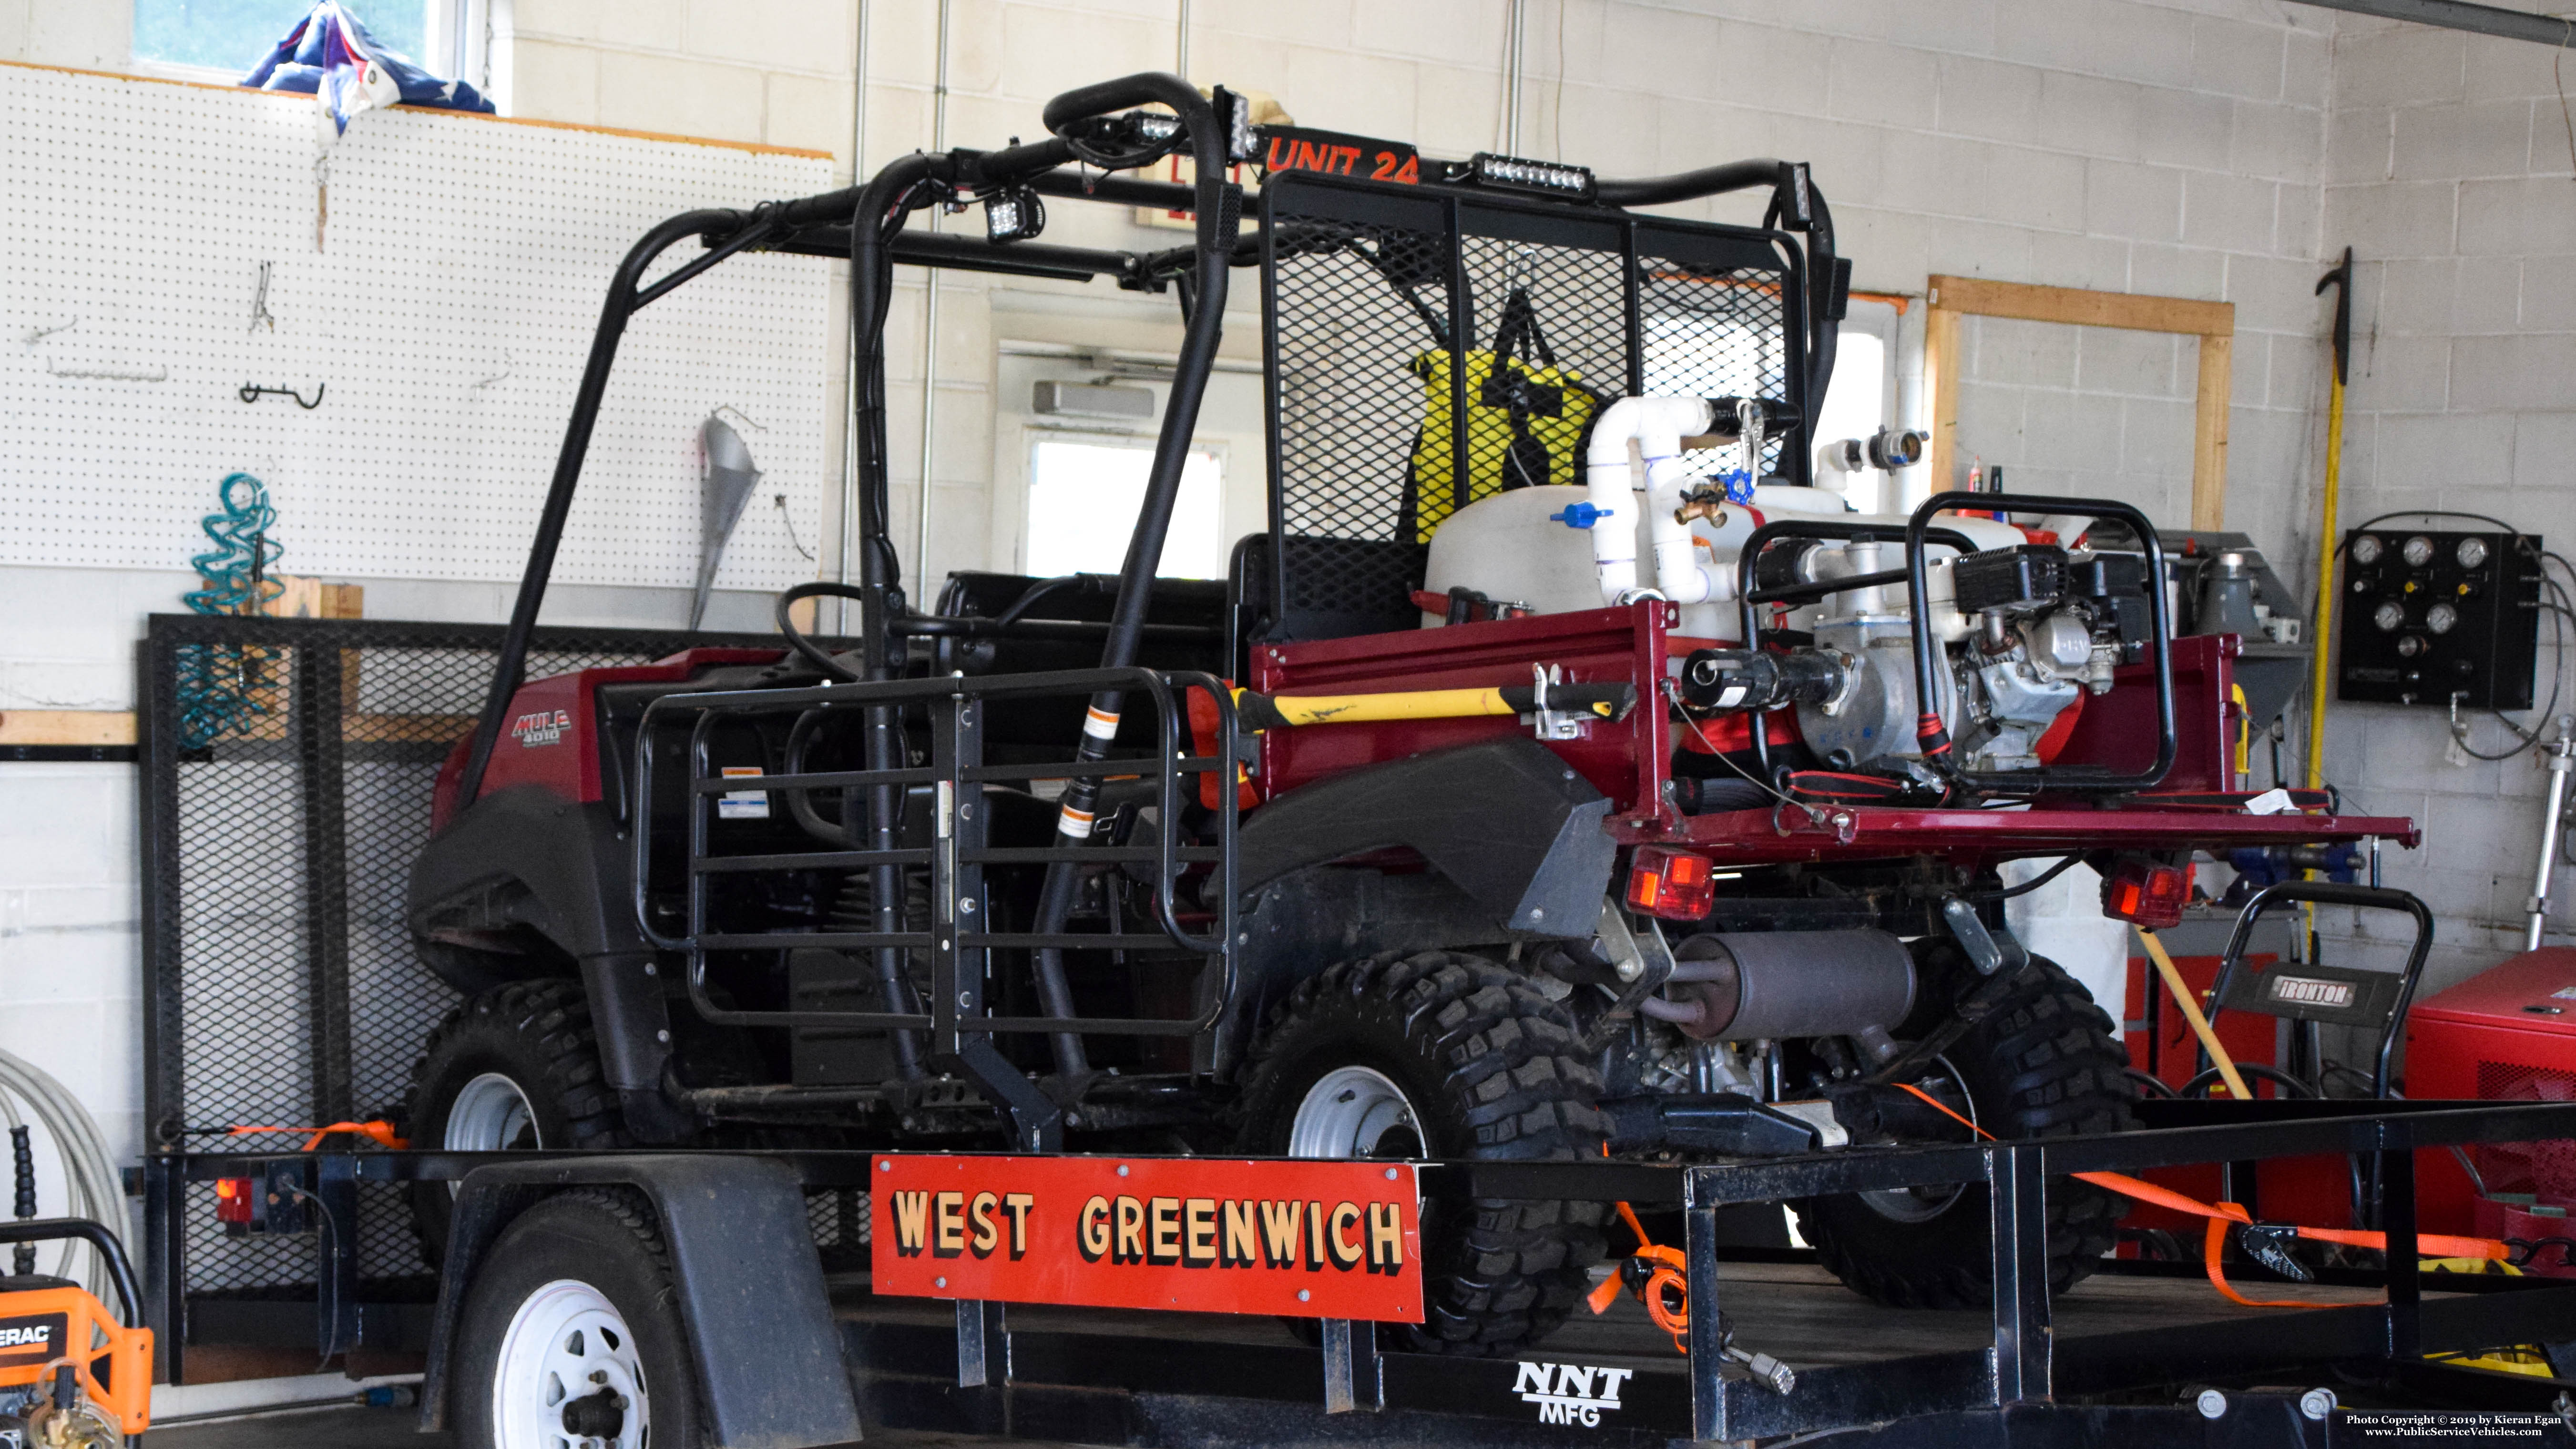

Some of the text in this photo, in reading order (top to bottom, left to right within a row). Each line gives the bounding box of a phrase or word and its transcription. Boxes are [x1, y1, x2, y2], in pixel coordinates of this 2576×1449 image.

[1267, 137, 1419, 185] UNIT 24
[511, 710, 571, 736] MULE
[523, 730, 560, 743] 4010
[2279, 980, 2348, 1003] IRONTON
[890, 1190, 1403, 1276] WEST GREENWICH
[1512, 1362, 1632, 1400] NNT
[1539, 1402, 1600, 1427] MFG
